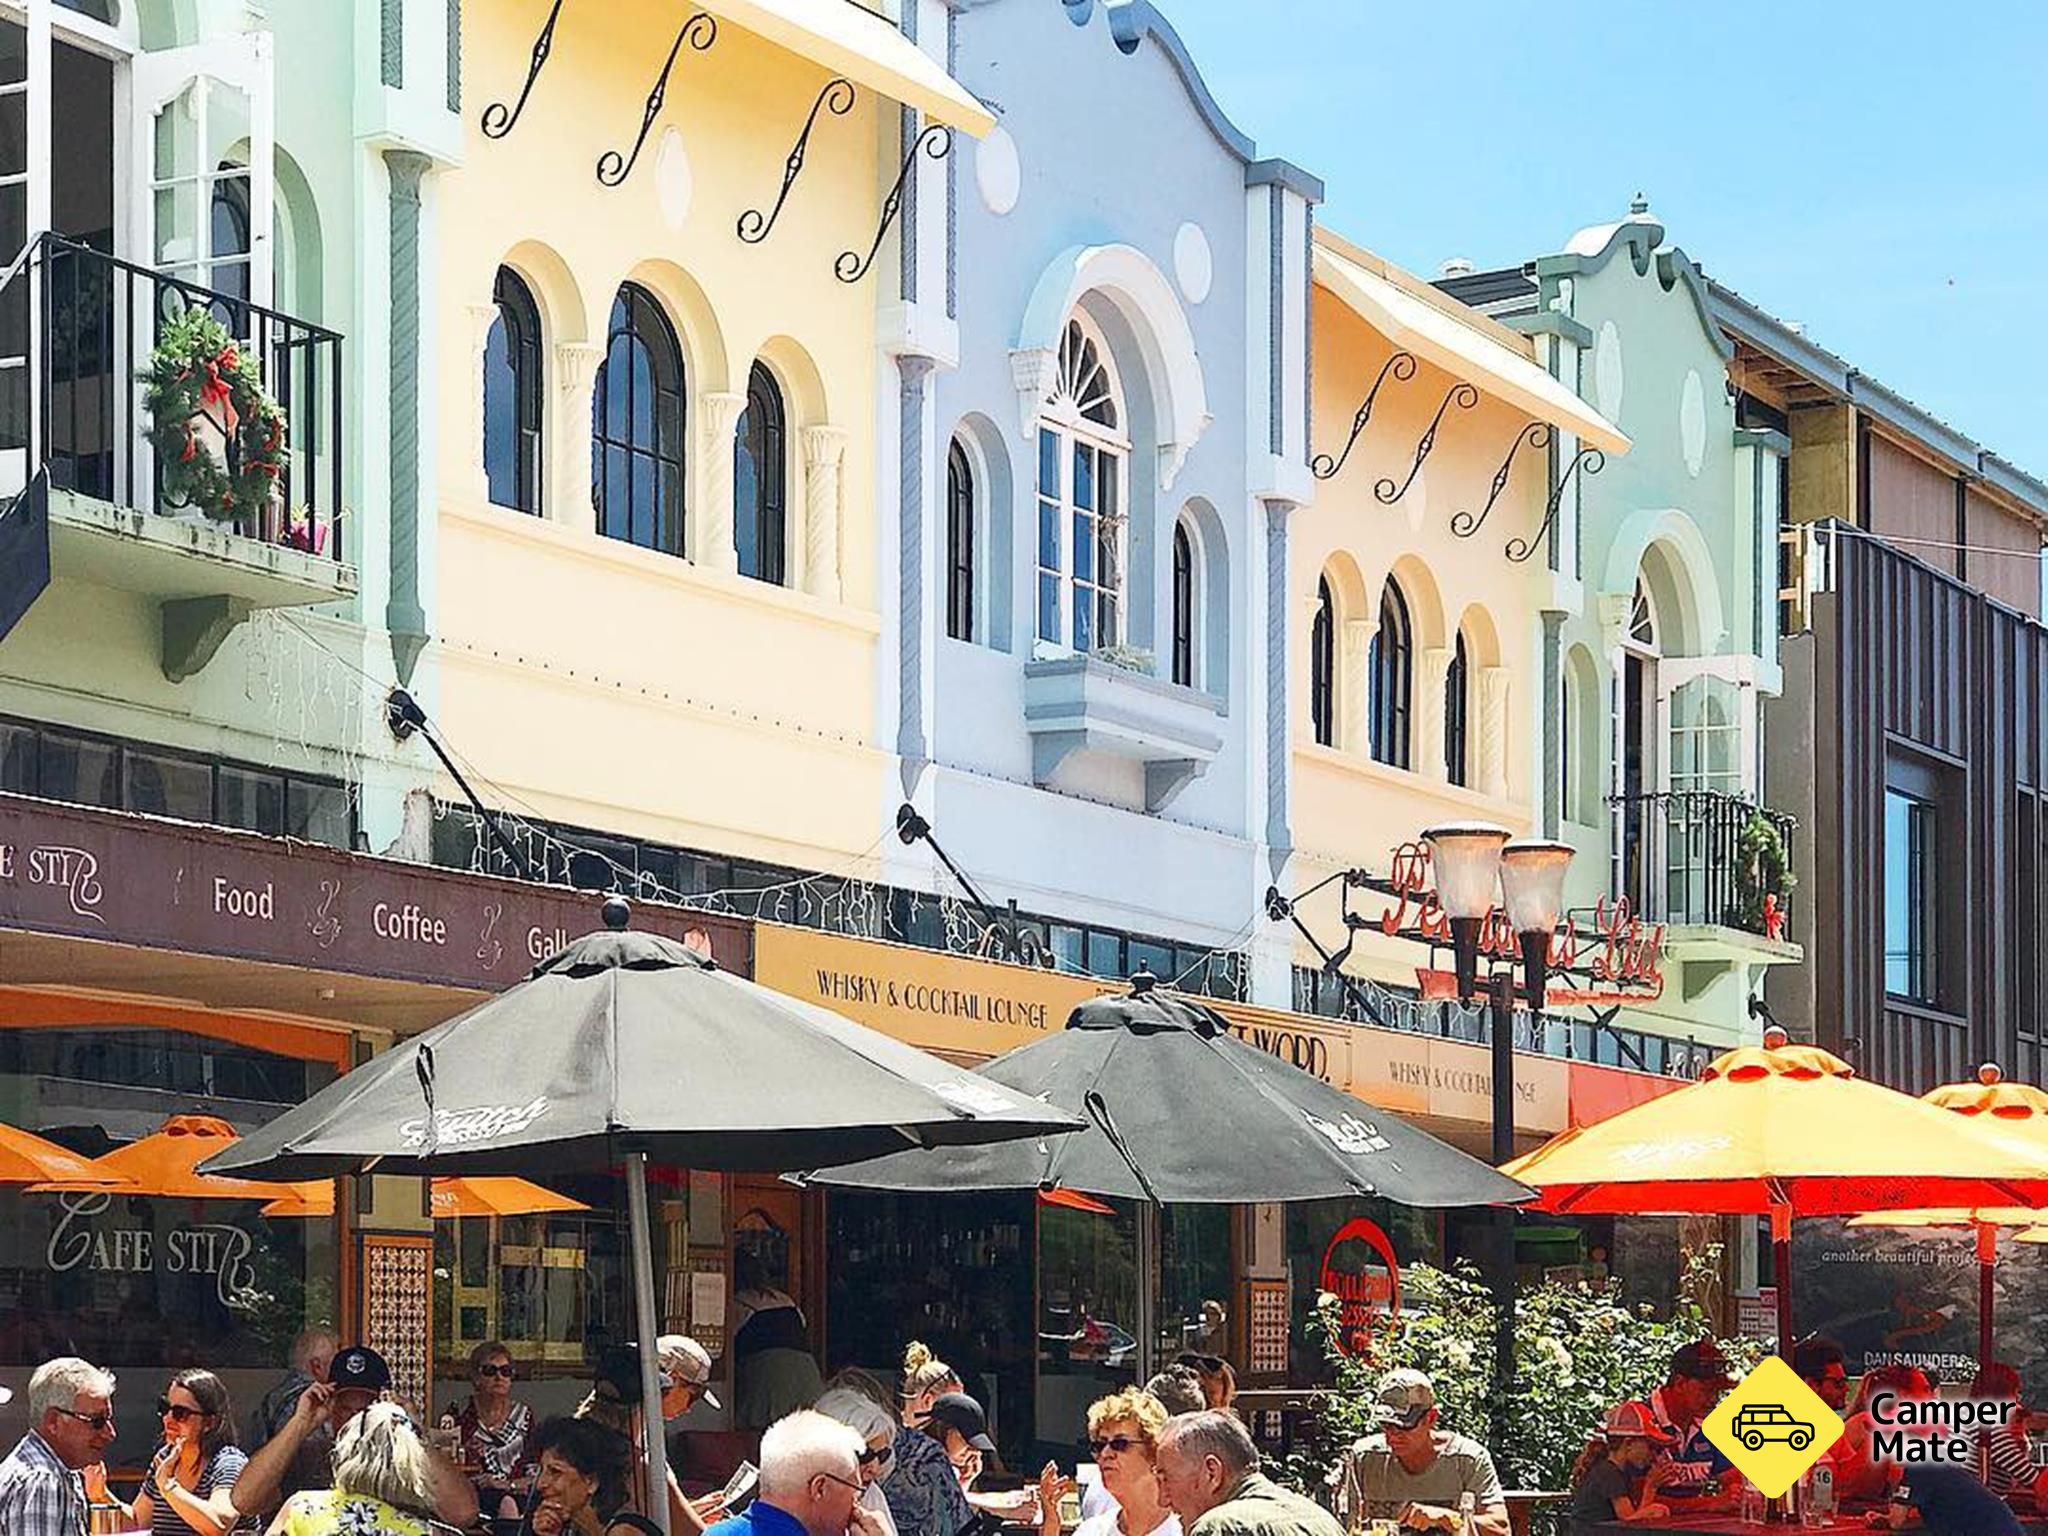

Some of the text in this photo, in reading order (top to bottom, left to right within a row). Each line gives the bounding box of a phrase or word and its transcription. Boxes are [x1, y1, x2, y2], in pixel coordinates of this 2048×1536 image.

[29, 844, 106, 924] STIR
[214, 878, 274, 920] Food
[373, 903, 447, 945] Coffee
[528, 926, 567, 959] Gall
[816, 969, 1048, 1031] WHISKY & COCKTAIL LOUNGE
[47, 1192, 258, 1313] CAFE STIR
[1821, 1248, 1979, 1268] another beautiful projec
[1816, 1470, 1831, 1484] 16
